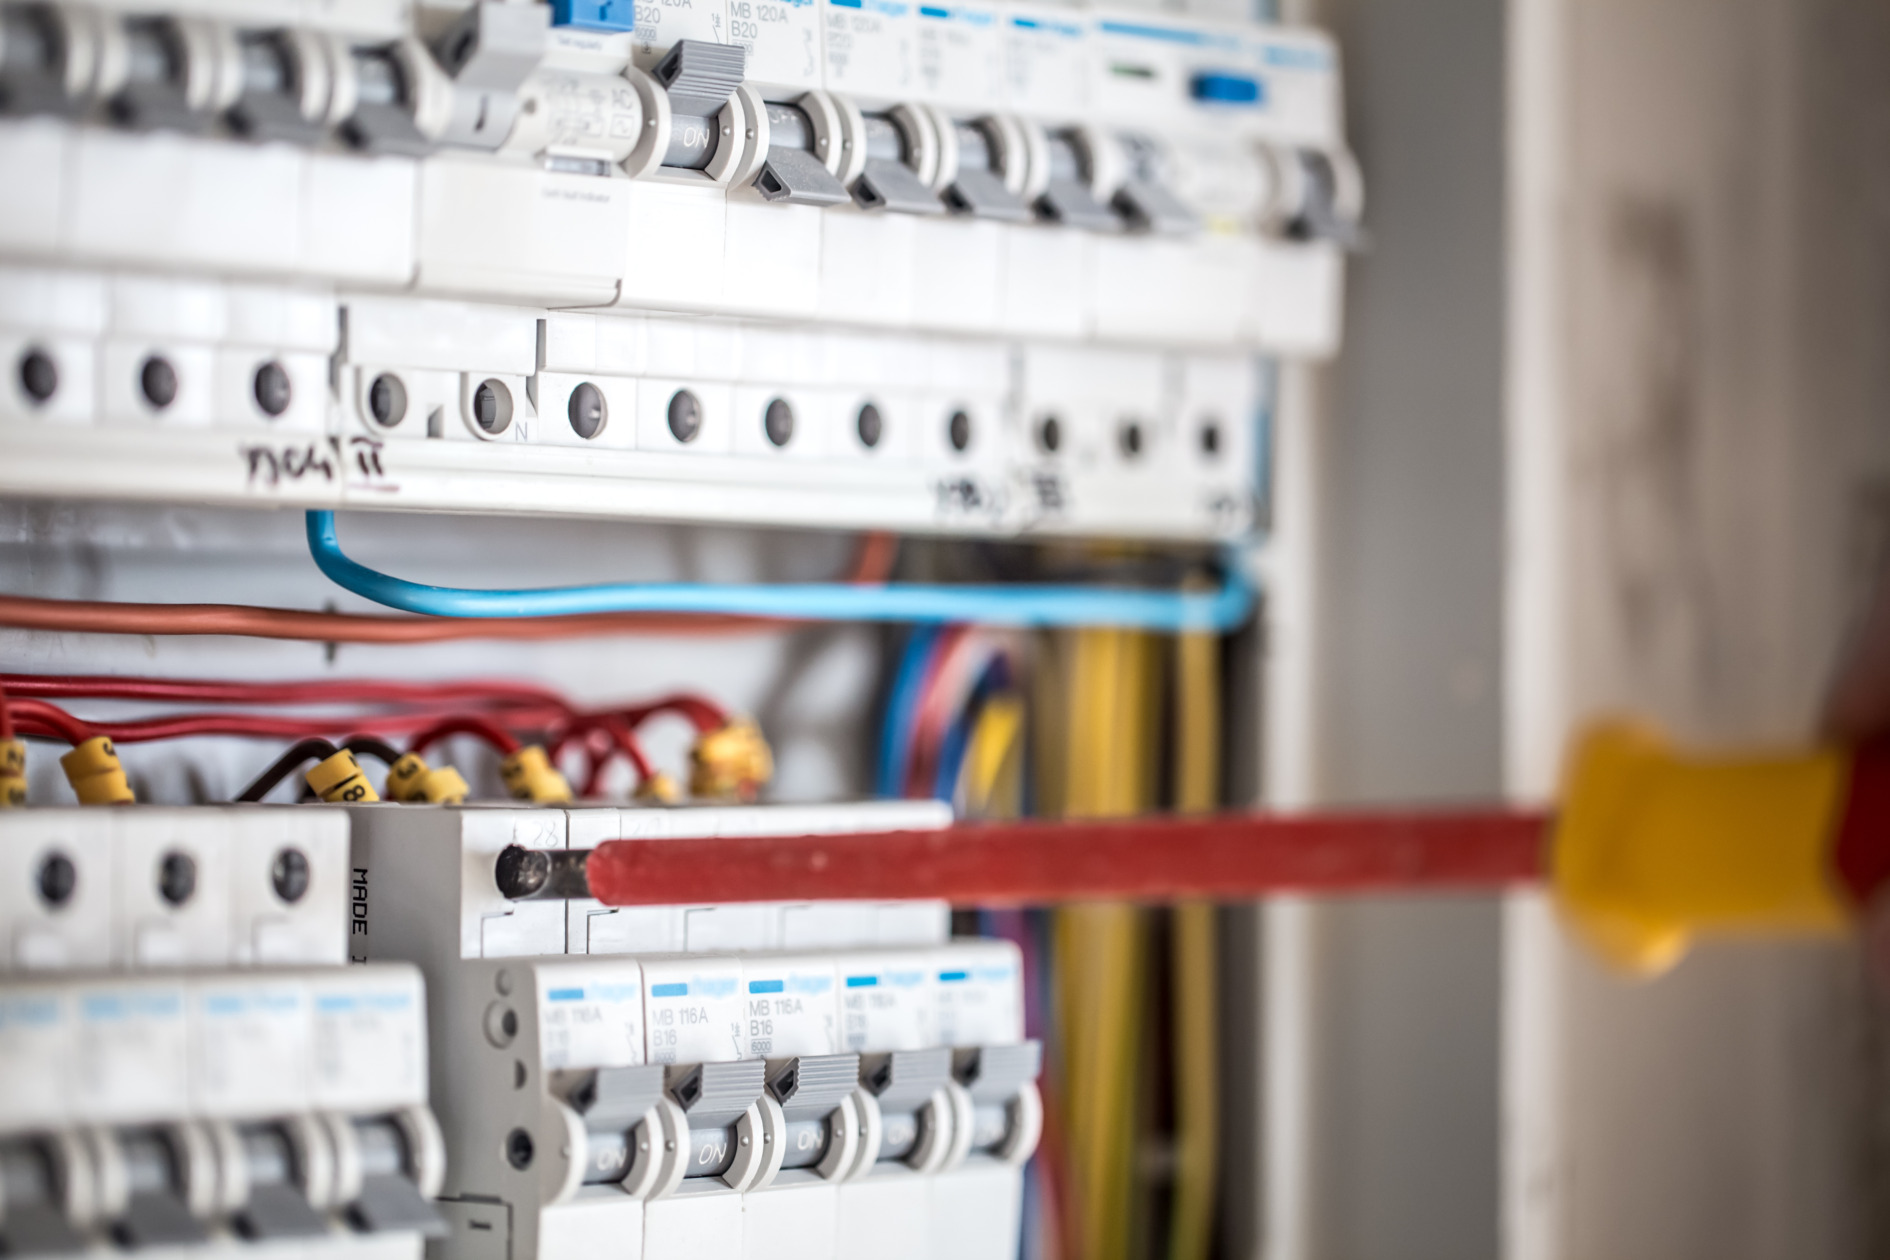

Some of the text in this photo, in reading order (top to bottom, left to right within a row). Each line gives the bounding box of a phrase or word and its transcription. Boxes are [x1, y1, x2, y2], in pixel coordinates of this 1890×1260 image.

[634, 4, 661, 24] B20
[730, 0, 752, 19] MB
[756, 5, 789, 24] 120A
[731, 20, 758, 39] B20
[683, 126, 710, 149] ON
[515, 420, 528, 442] N
[352, 867, 368, 936] MADE
[652, 1005, 709, 1027] MB 116A
[749, 999, 770, 1017] MB
[653, 1028, 678, 1047] B16
[750, 1018, 774, 1037] B16
[751, 1040, 772, 1053] 6000
[797, 1128, 824, 1151] ON
[698, 1142, 728, 1165] ON
